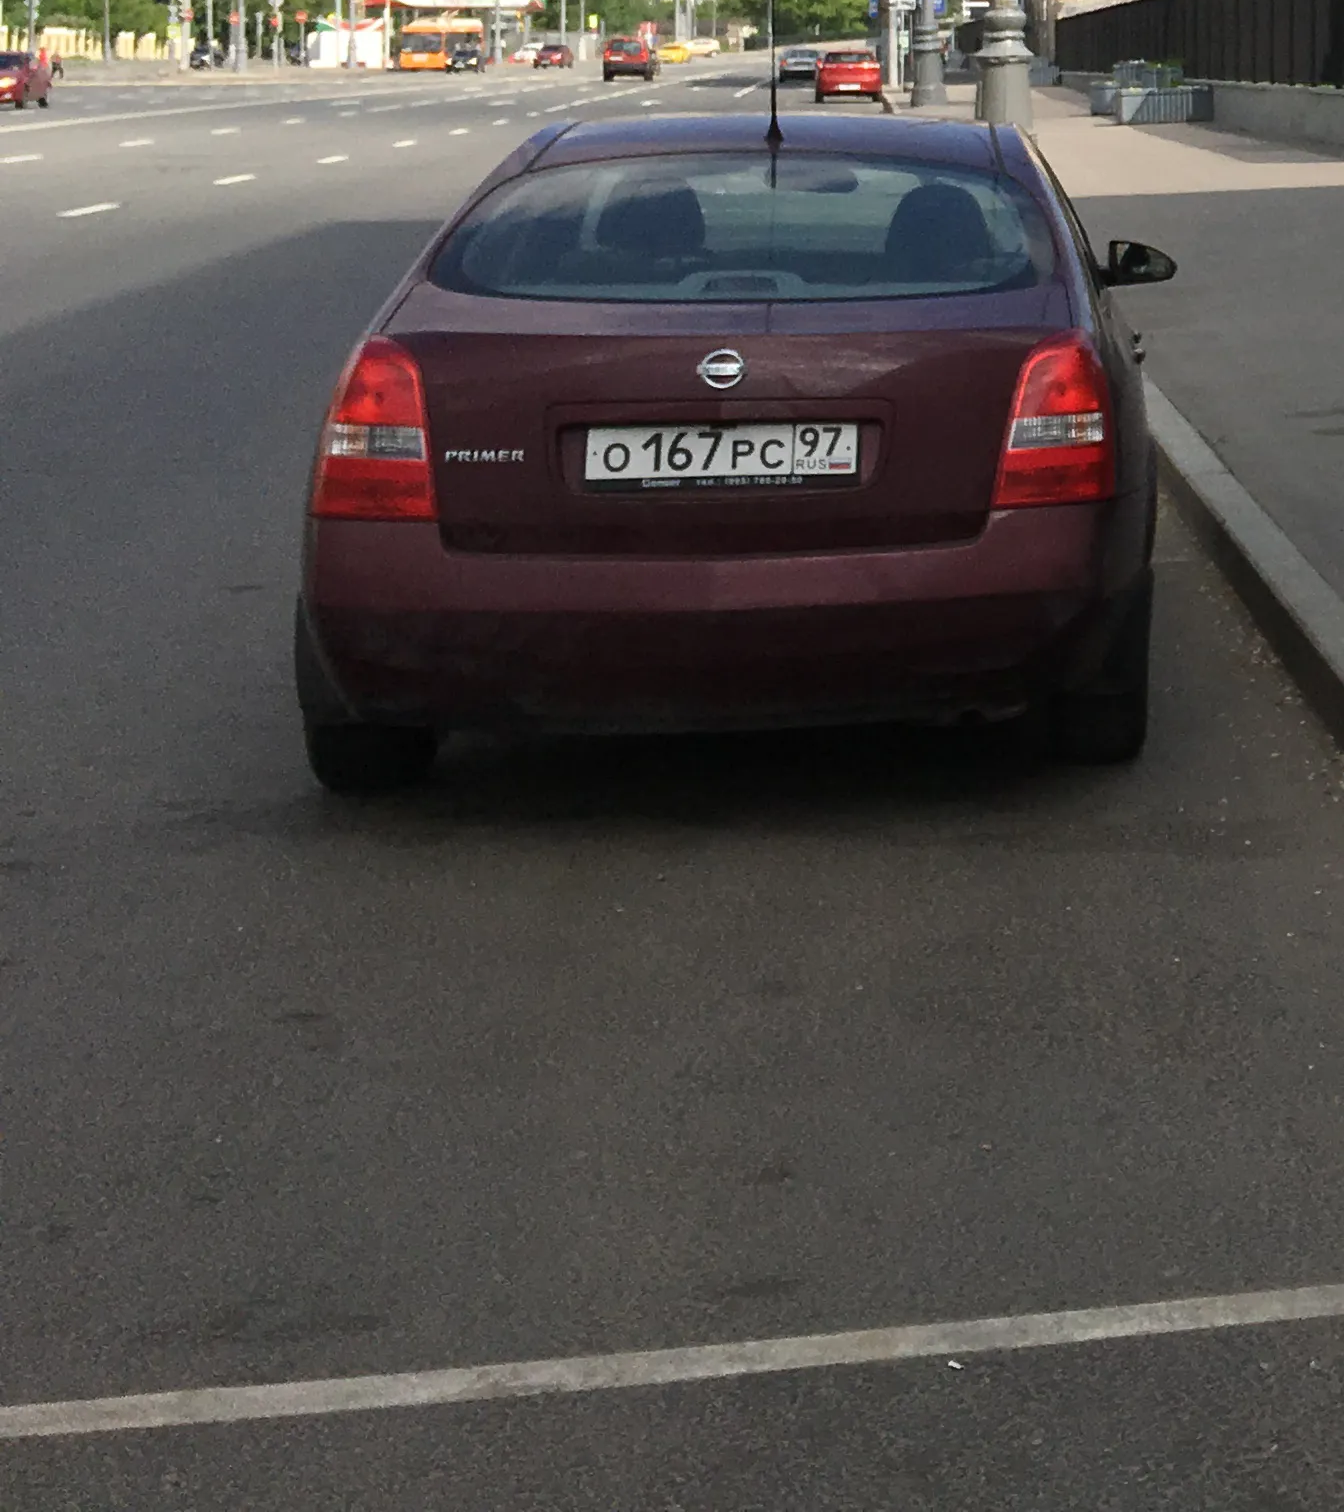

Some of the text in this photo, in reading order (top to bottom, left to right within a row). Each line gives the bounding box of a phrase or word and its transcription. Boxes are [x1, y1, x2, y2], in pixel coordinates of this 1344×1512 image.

[799, 426, 844, 458] 97
[444, 448, 525, 463] PRIMER
[795, 459, 828, 470] RUS
